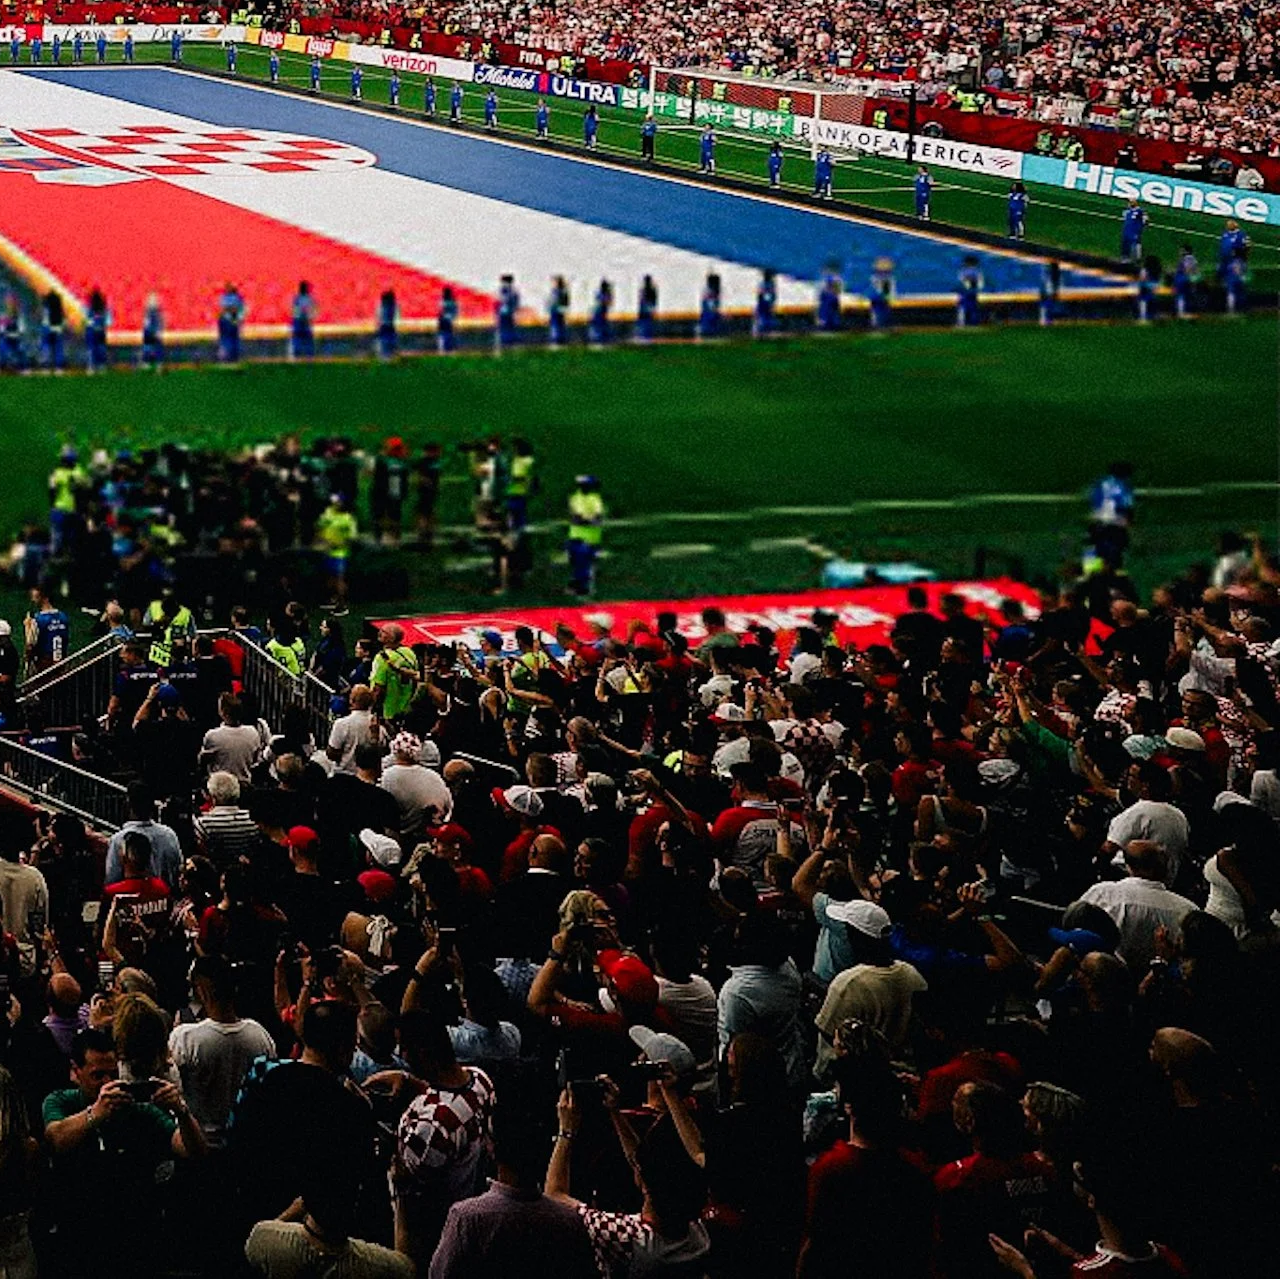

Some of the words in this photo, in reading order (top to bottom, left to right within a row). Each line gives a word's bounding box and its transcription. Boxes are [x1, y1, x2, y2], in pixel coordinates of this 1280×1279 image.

[381, 52, 438, 74] verizon
[520, 50, 544, 66] FIFA
[474, 66, 536, 91] Michelob
[552, 78, 616, 105] ULTRA
[858, 133, 882, 151] OF
[1064, 160, 1270, 224] Hisense
